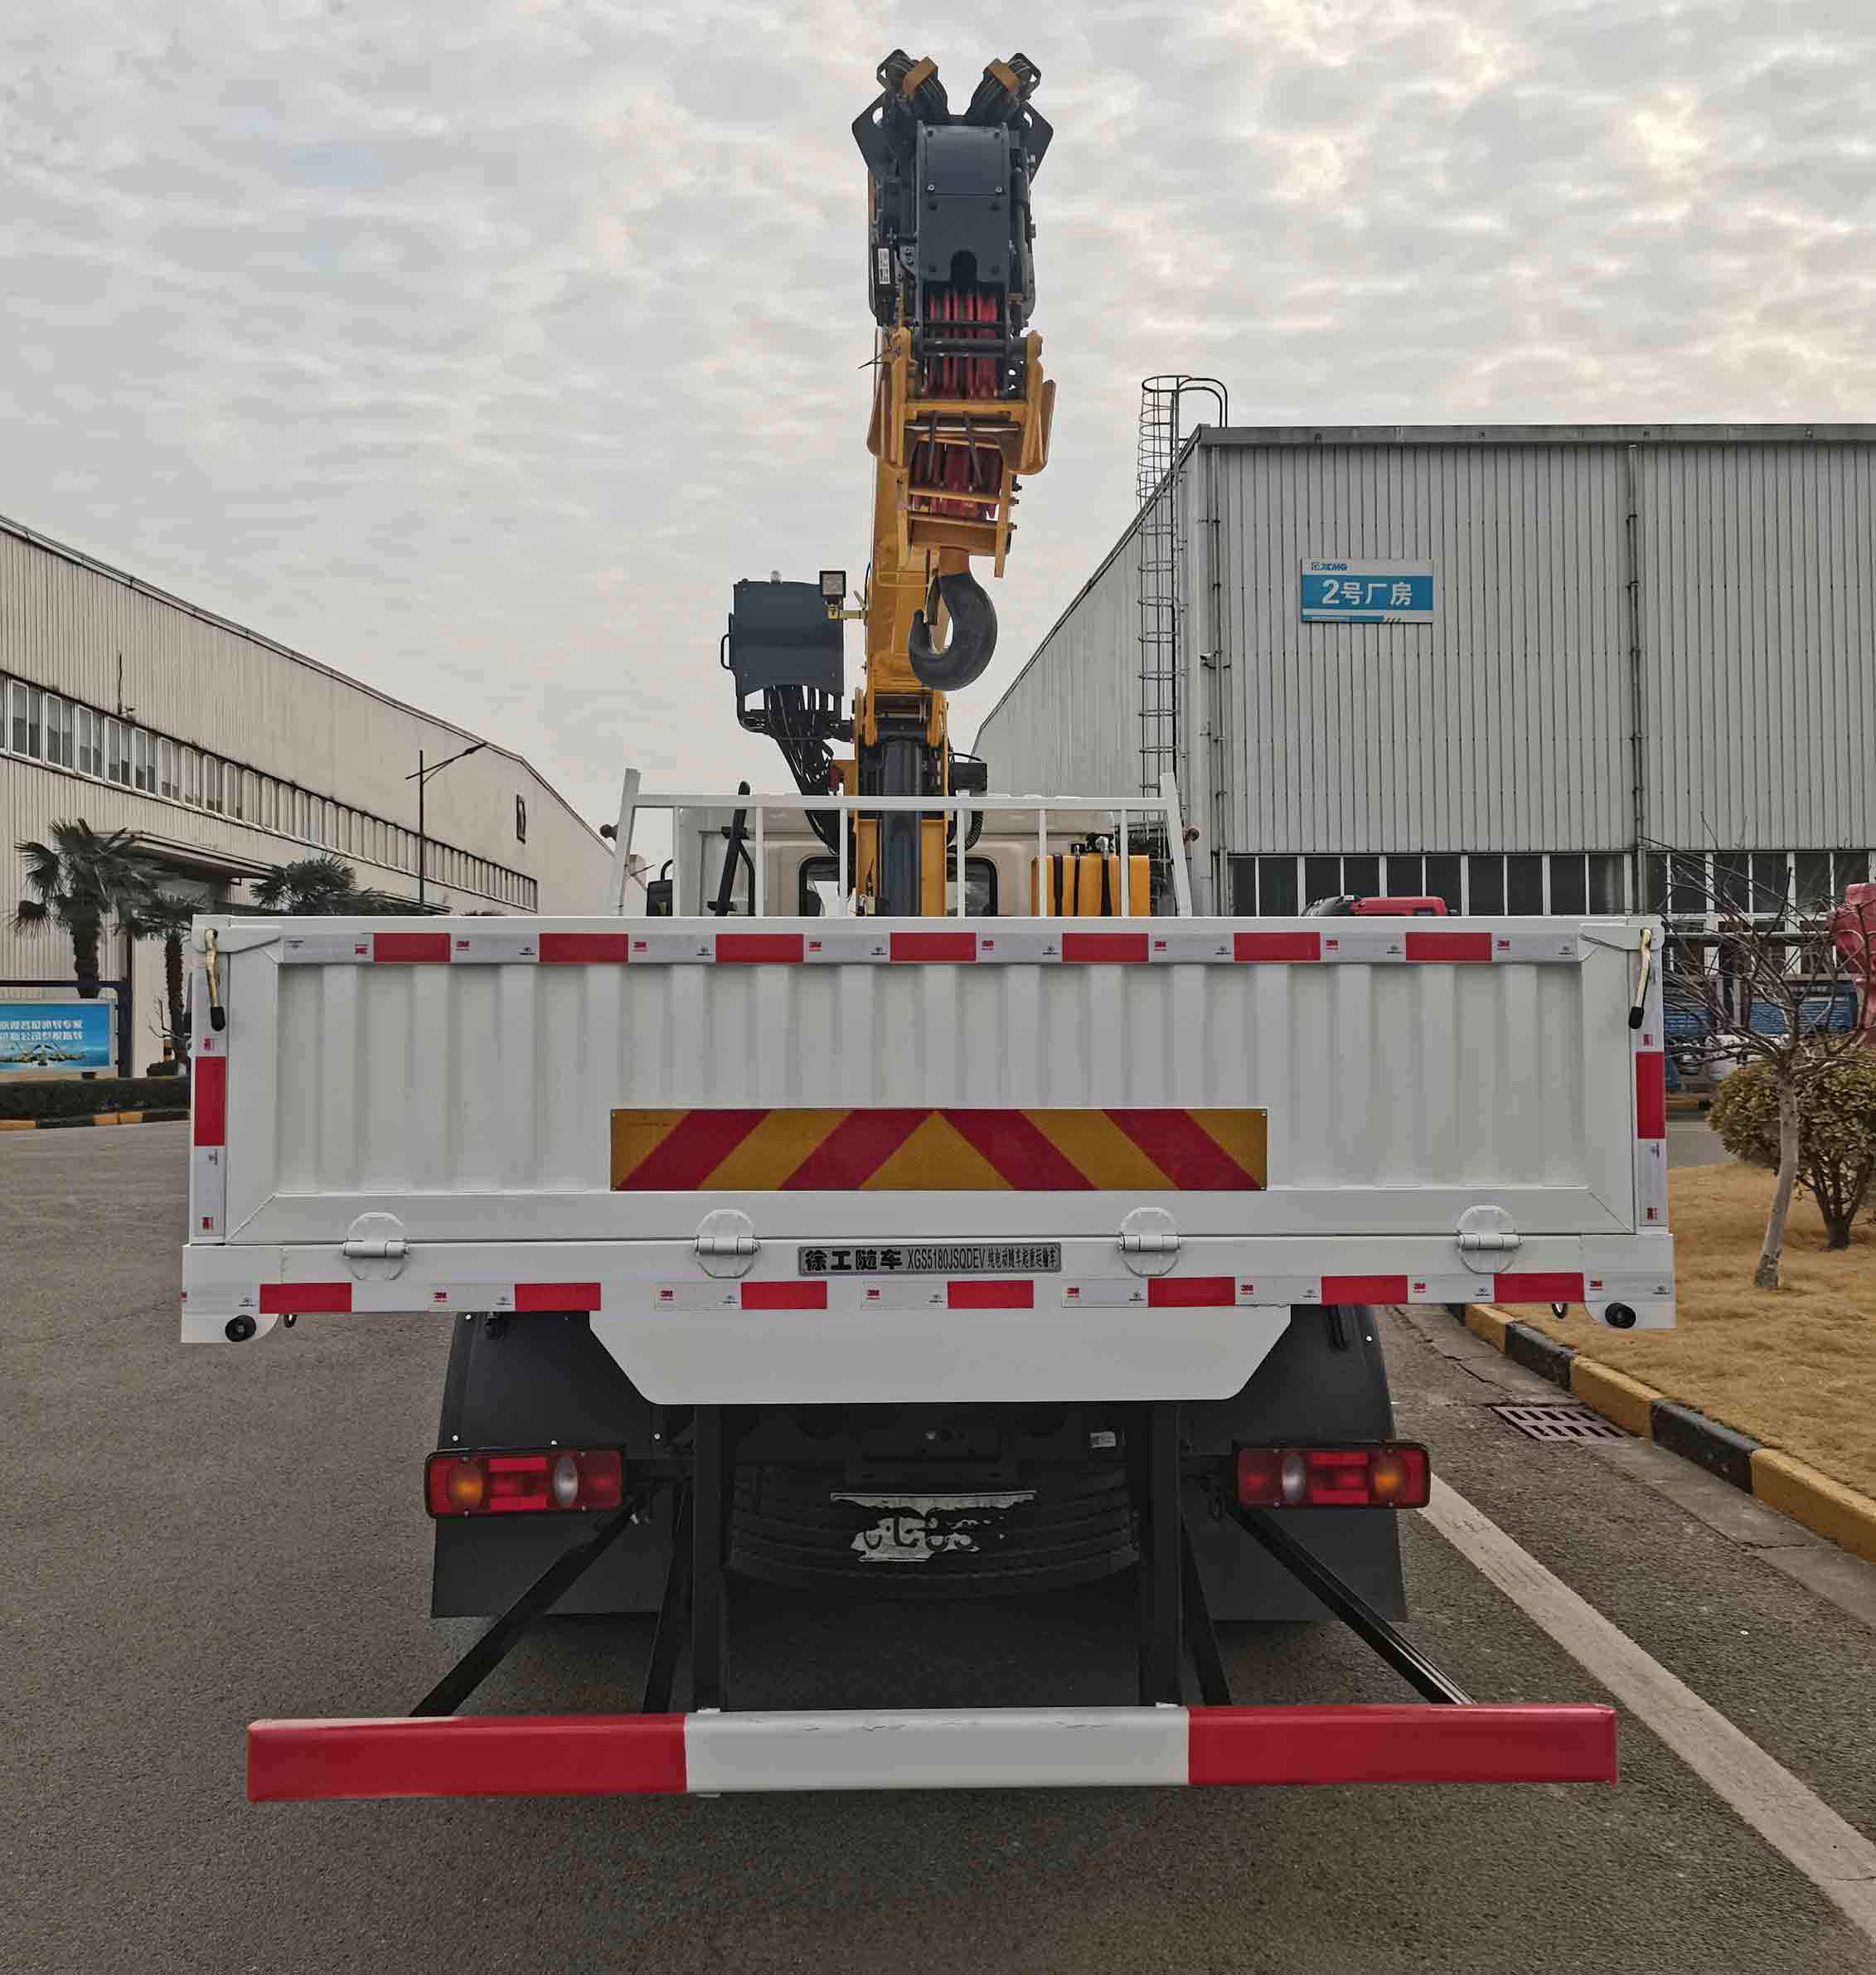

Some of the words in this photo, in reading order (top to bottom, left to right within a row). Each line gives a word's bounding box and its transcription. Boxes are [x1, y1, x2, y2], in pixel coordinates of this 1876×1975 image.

[1322, 579, 1413, 606] 2号厂房
[805, 1249, 903, 1271] 徐工随车
[908, 1247, 985, 1269] XGS5180JSQDEV
